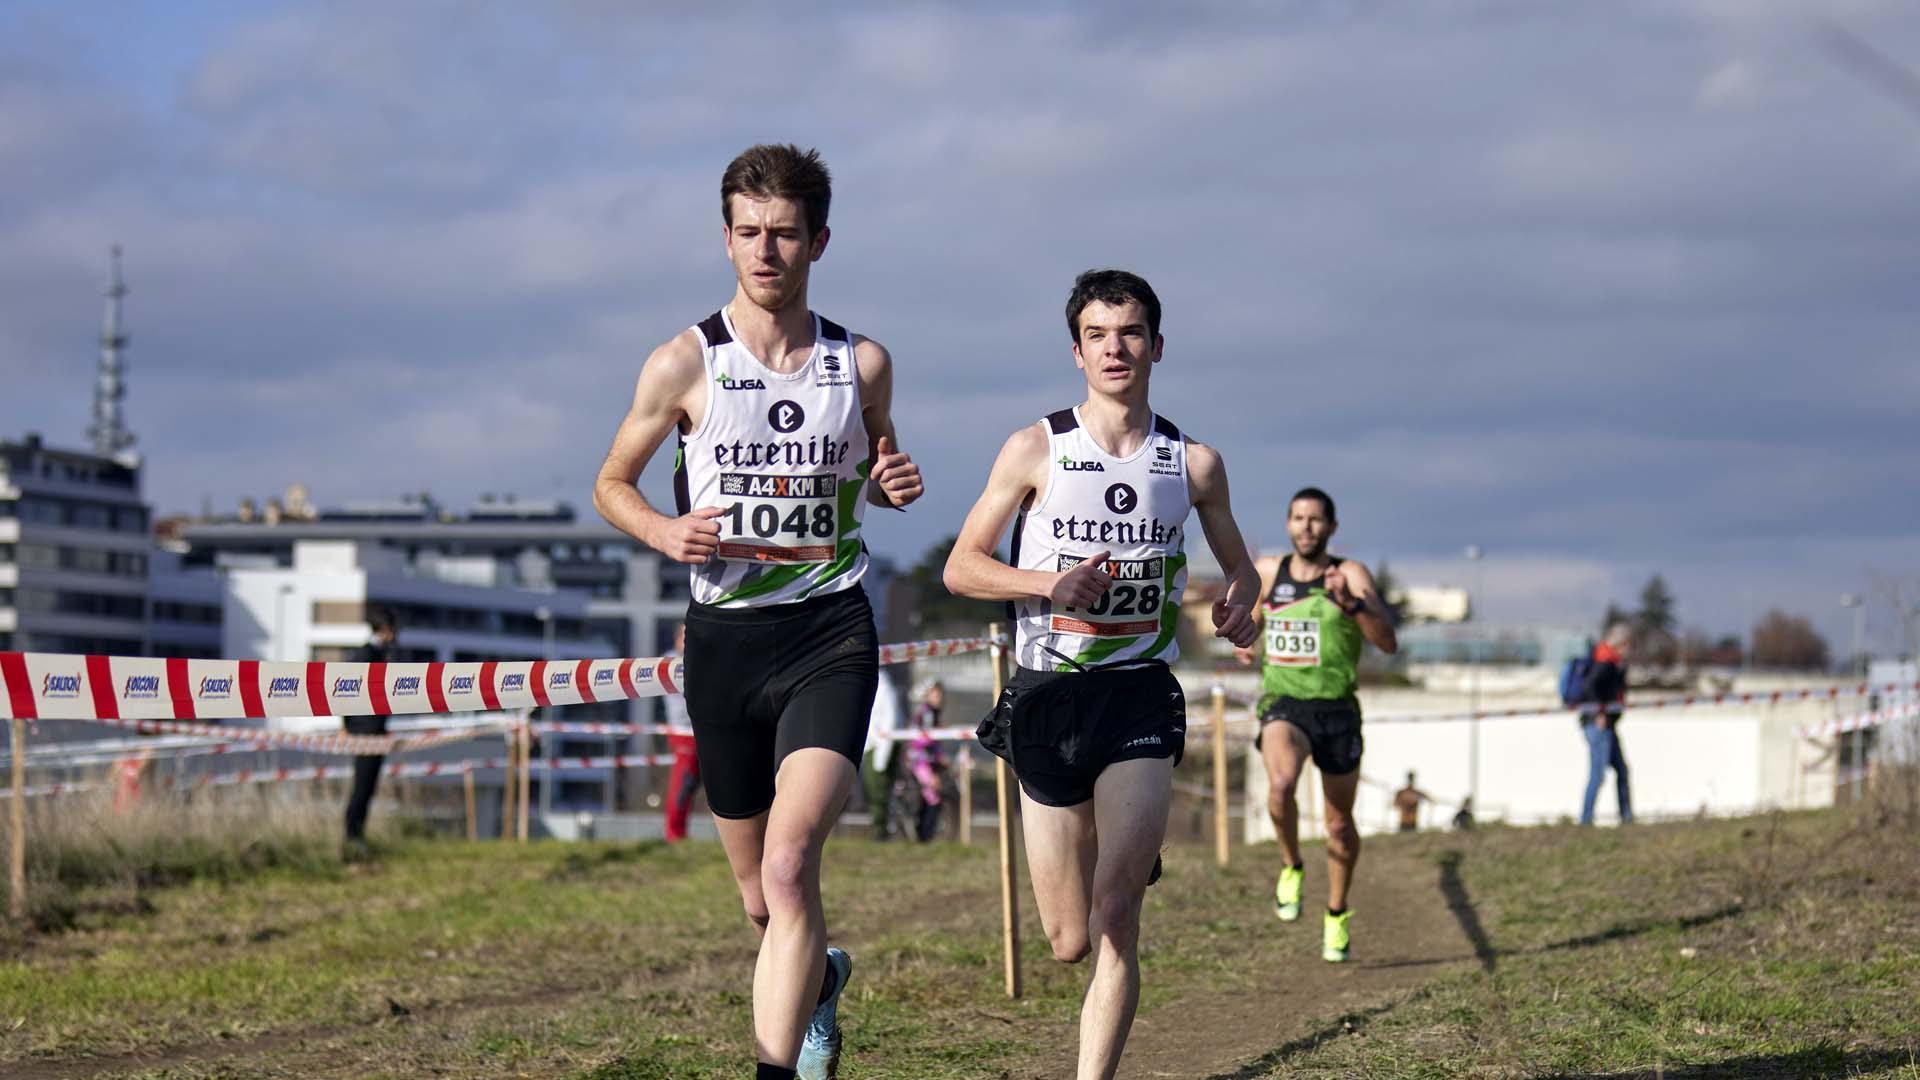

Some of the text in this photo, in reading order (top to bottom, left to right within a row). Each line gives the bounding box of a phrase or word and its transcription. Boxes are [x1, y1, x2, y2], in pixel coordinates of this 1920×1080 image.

[722, 379, 767, 391] LUGA
[714, 434, 849, 468] etxenike
[1064, 460, 1105, 472] LUGA
[748, 476, 815, 497] A4XKM
[724, 501, 835, 538] 1048
[1066, 584, 1160, 616] 028
